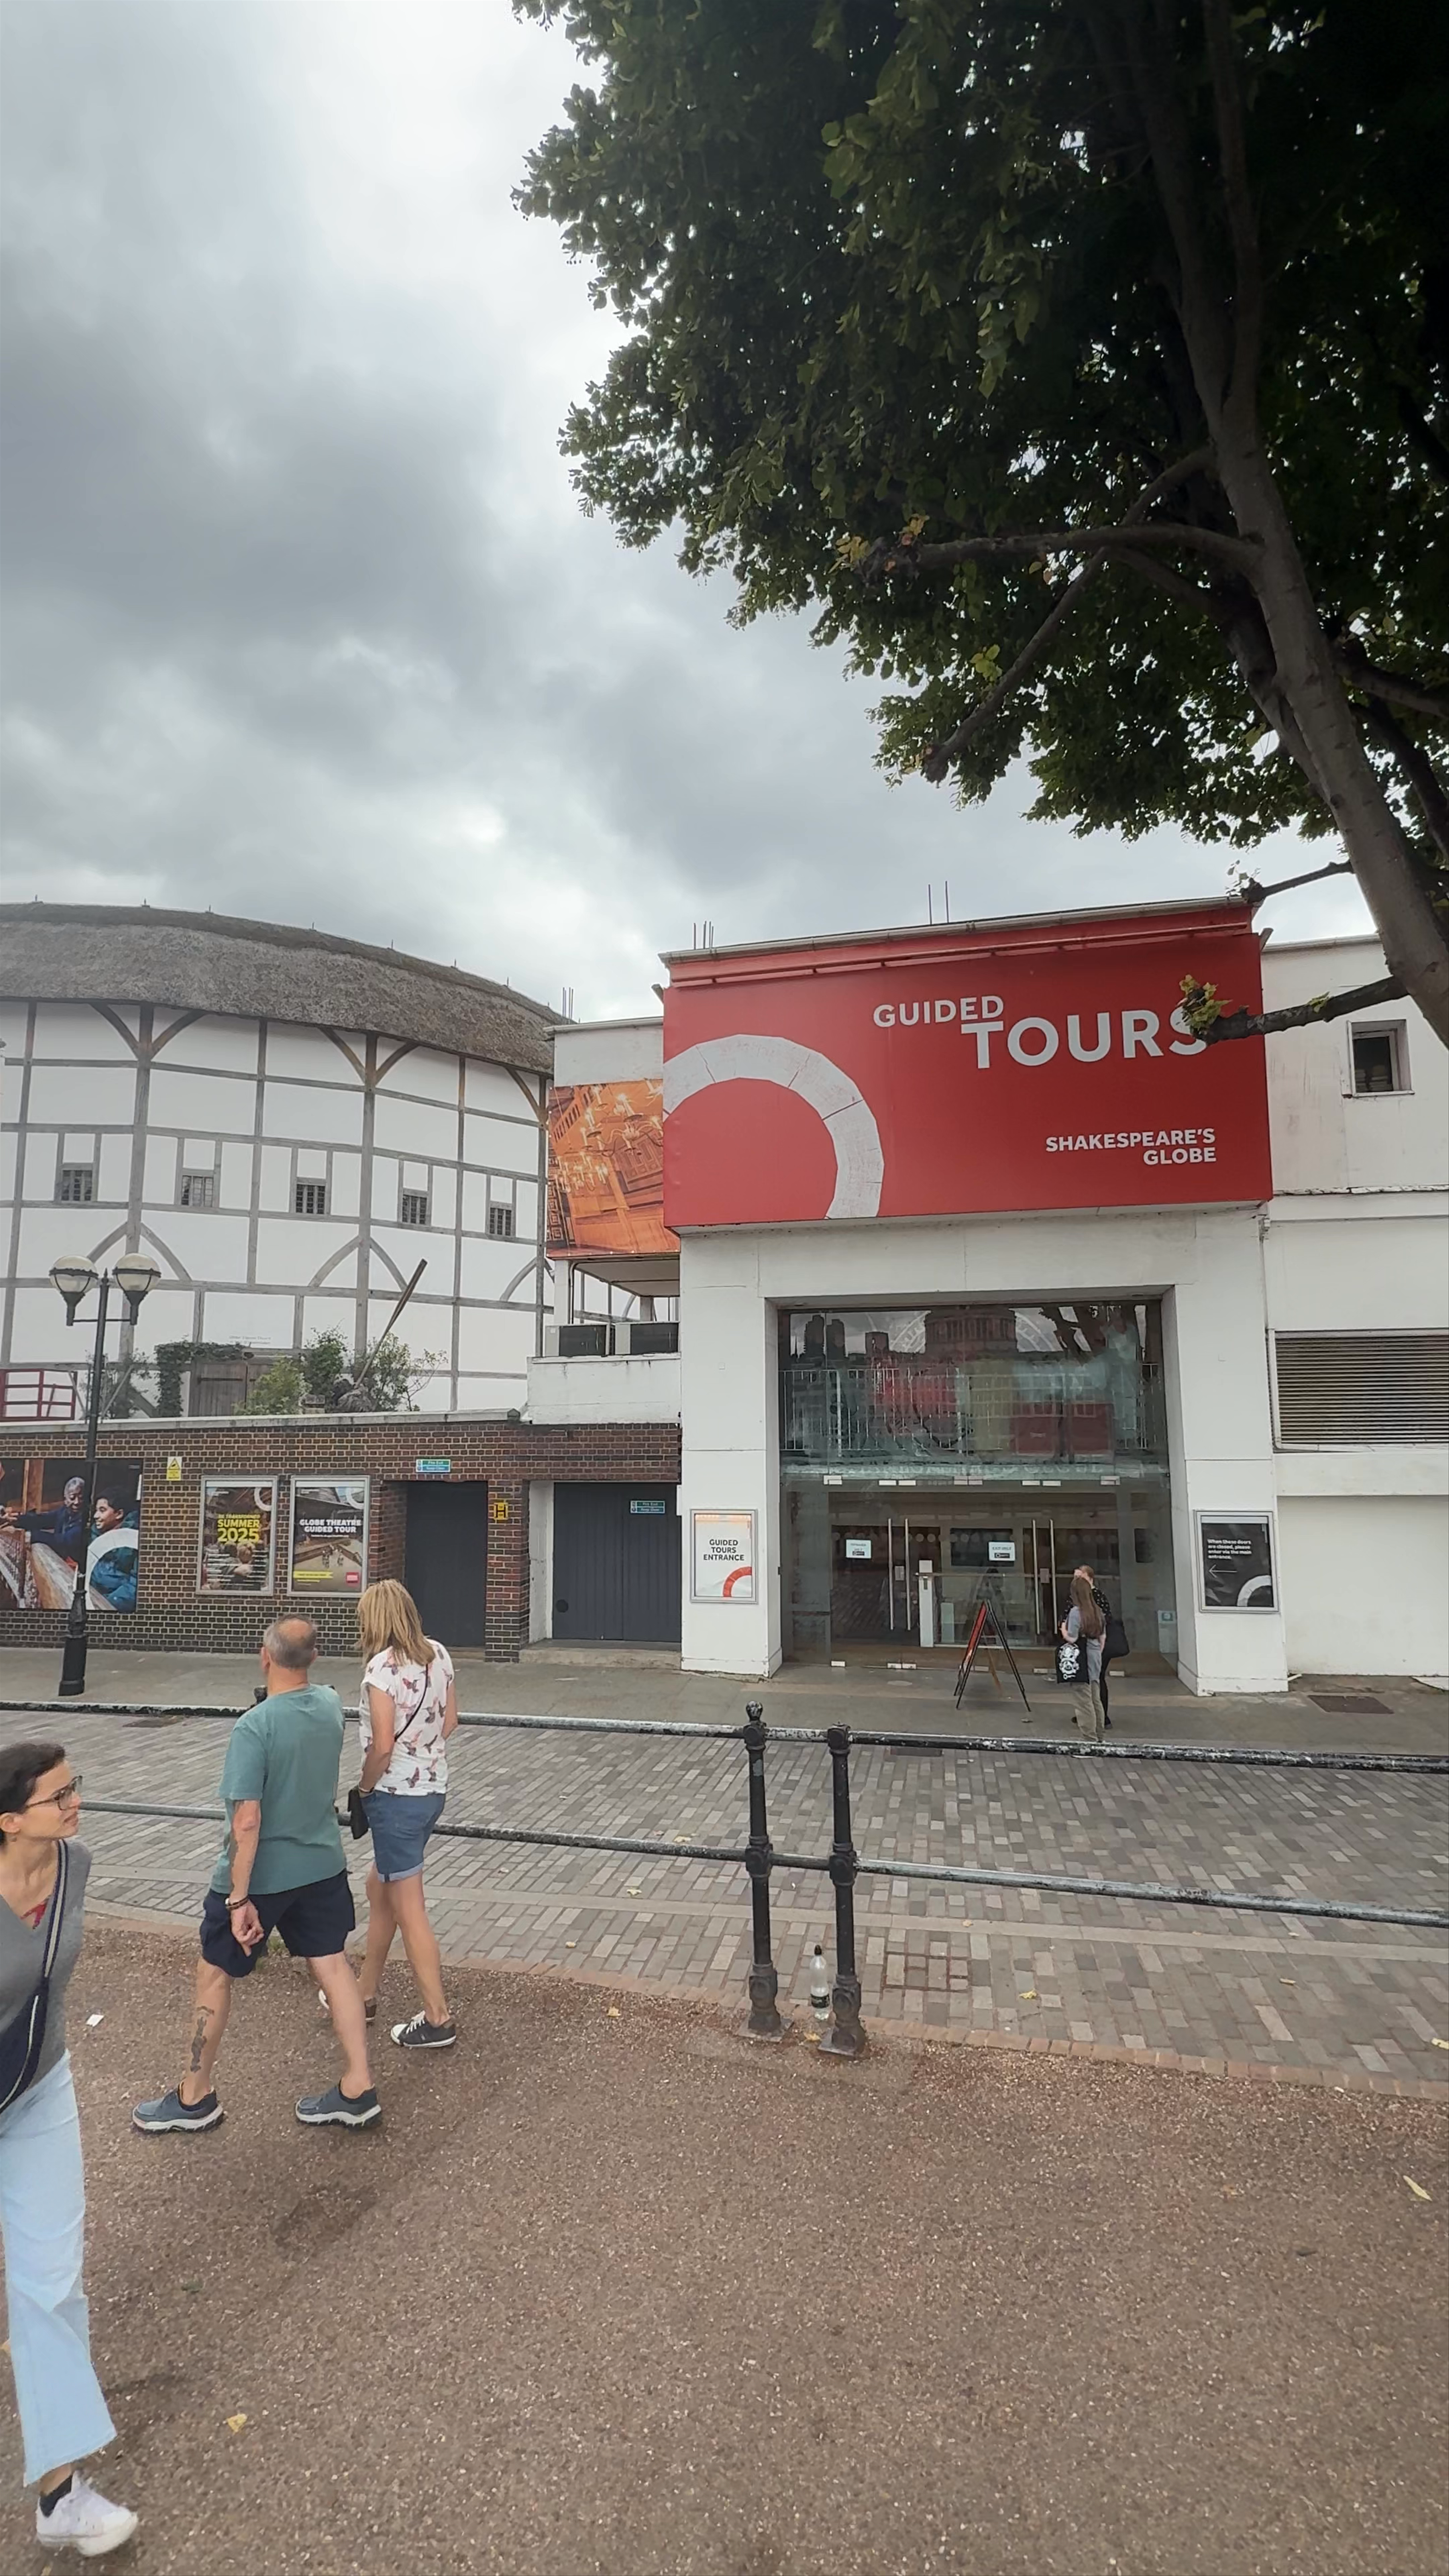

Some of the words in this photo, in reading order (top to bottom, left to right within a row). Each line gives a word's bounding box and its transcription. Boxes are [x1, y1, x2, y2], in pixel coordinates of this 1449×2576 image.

[873, 995, 1004, 1028] GUIDED
[961, 1005, 1208, 1069] TOURS
[1045, 1128, 1215, 1152] SHAKESPEARE'S
[1143, 1147, 1217, 1165] GLOBE
[496, 1504, 506, 1518] H
[218, 1519, 260, 1528] SUMMER
[218, 1527, 259, 1542] 2025
